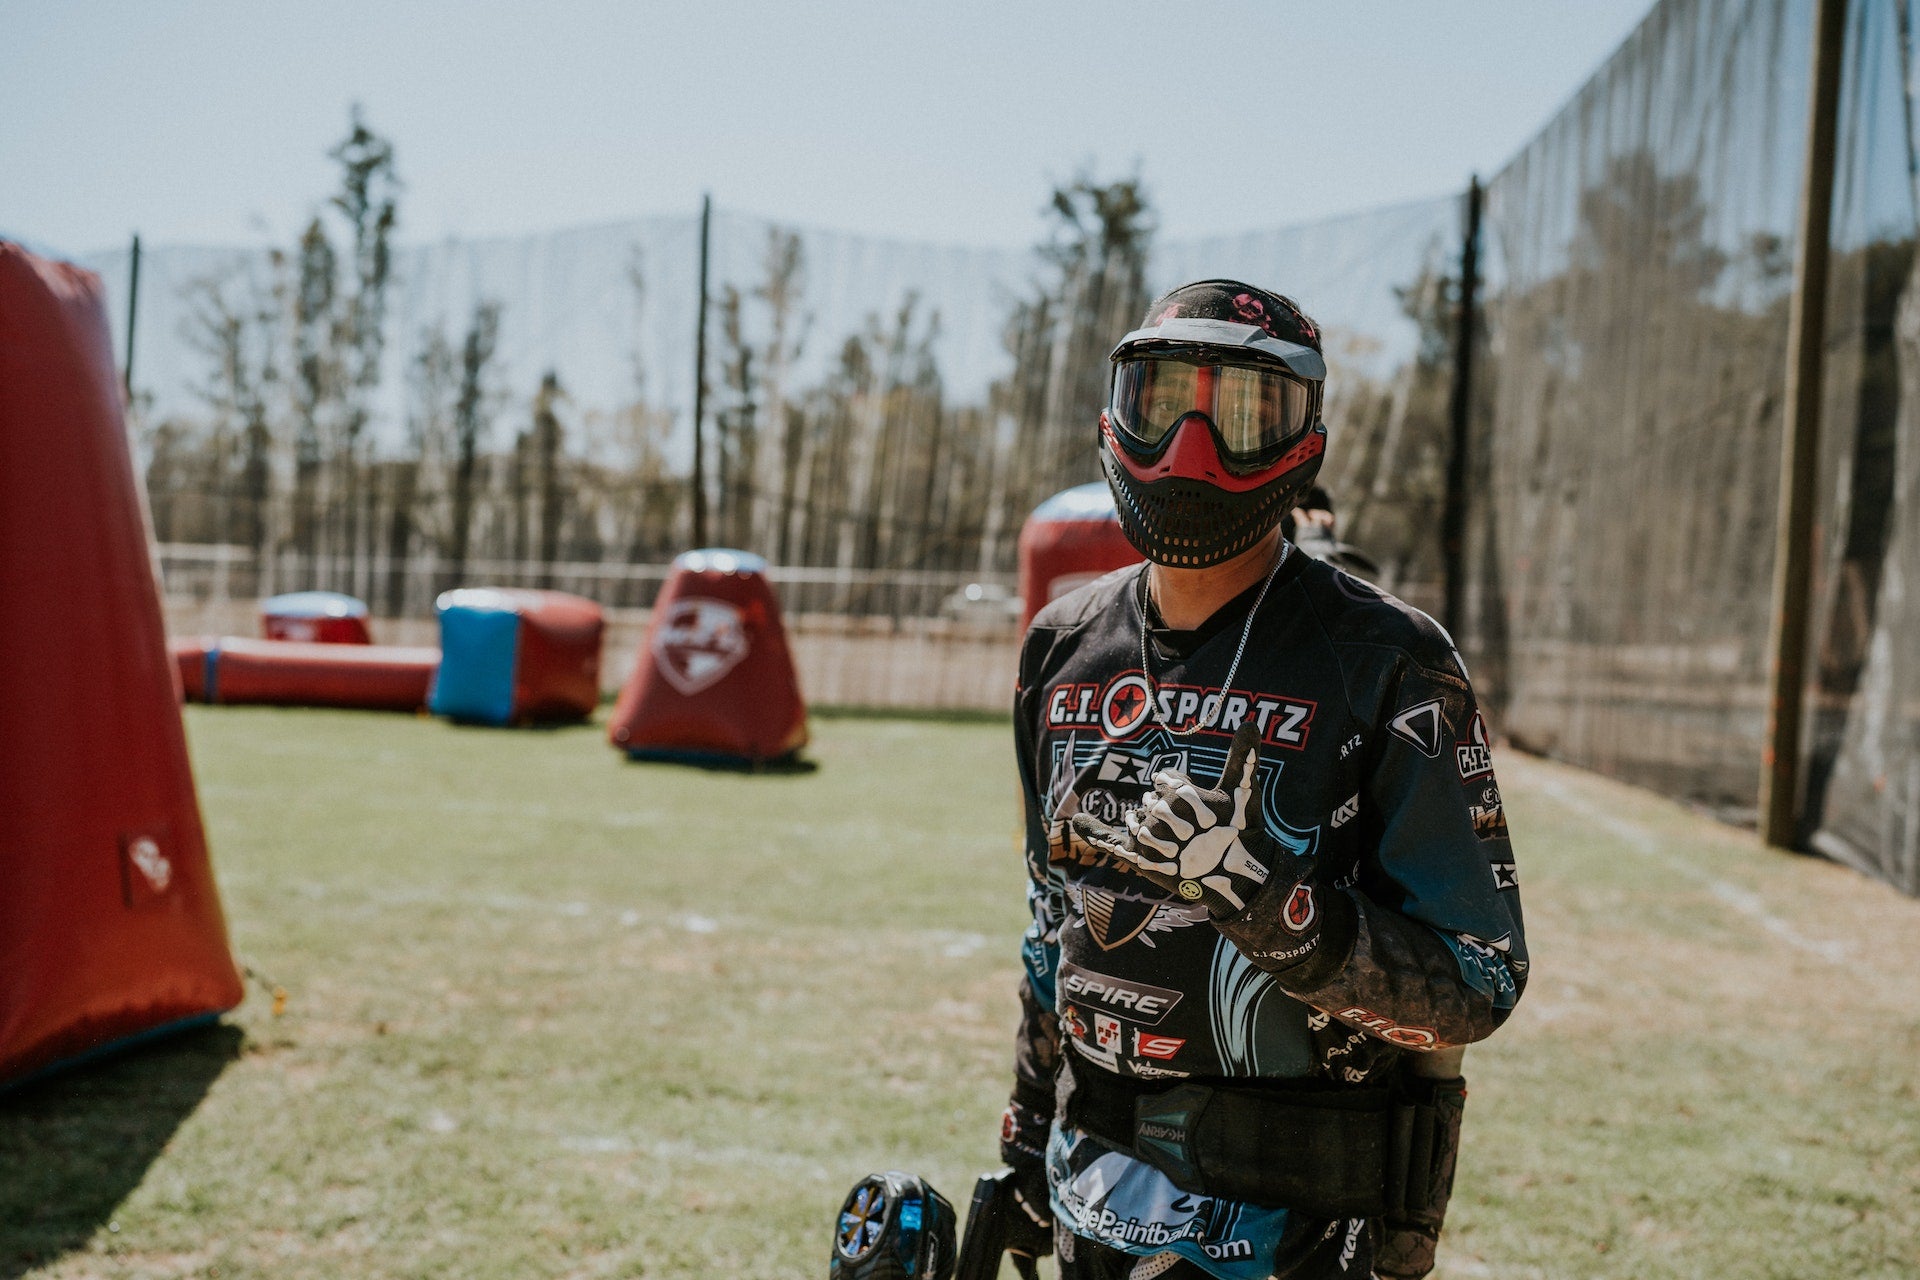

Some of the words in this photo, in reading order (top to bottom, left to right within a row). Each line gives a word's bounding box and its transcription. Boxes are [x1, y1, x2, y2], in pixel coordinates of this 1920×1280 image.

[1050, 690, 1098, 723] G.I.
[1154, 690, 1308, 742] SPORTZ
[1066, 974, 1169, 1015] SPIRE
[1097, 1026, 1119, 1040] PBT
